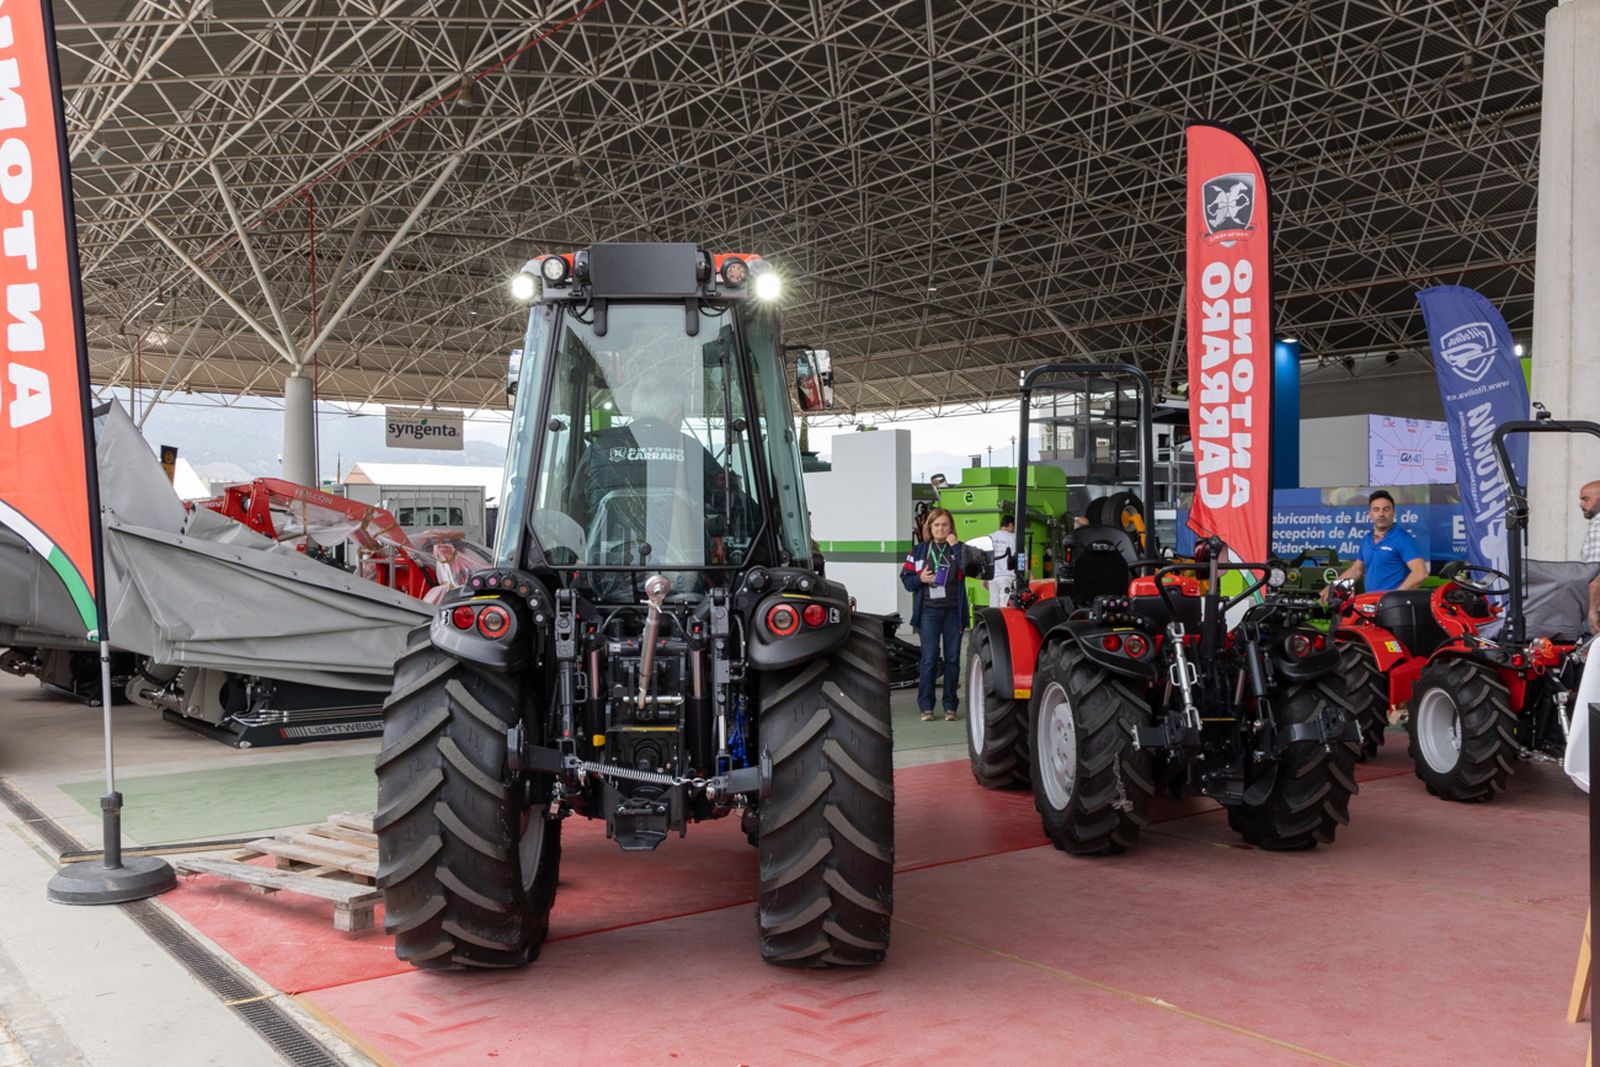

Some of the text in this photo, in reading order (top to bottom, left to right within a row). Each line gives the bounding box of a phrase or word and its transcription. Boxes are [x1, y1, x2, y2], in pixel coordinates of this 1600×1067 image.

[388, 423, 457, 440] syngenta
[627, 452, 685, 462] CARRARO
[1272, 510, 1419, 525] abricantes de Líns de
[1272, 527, 1325, 541] ecepción
[1328, 526, 1345, 539] de
[307, 720, 384, 735] LIGHTWEIGH
